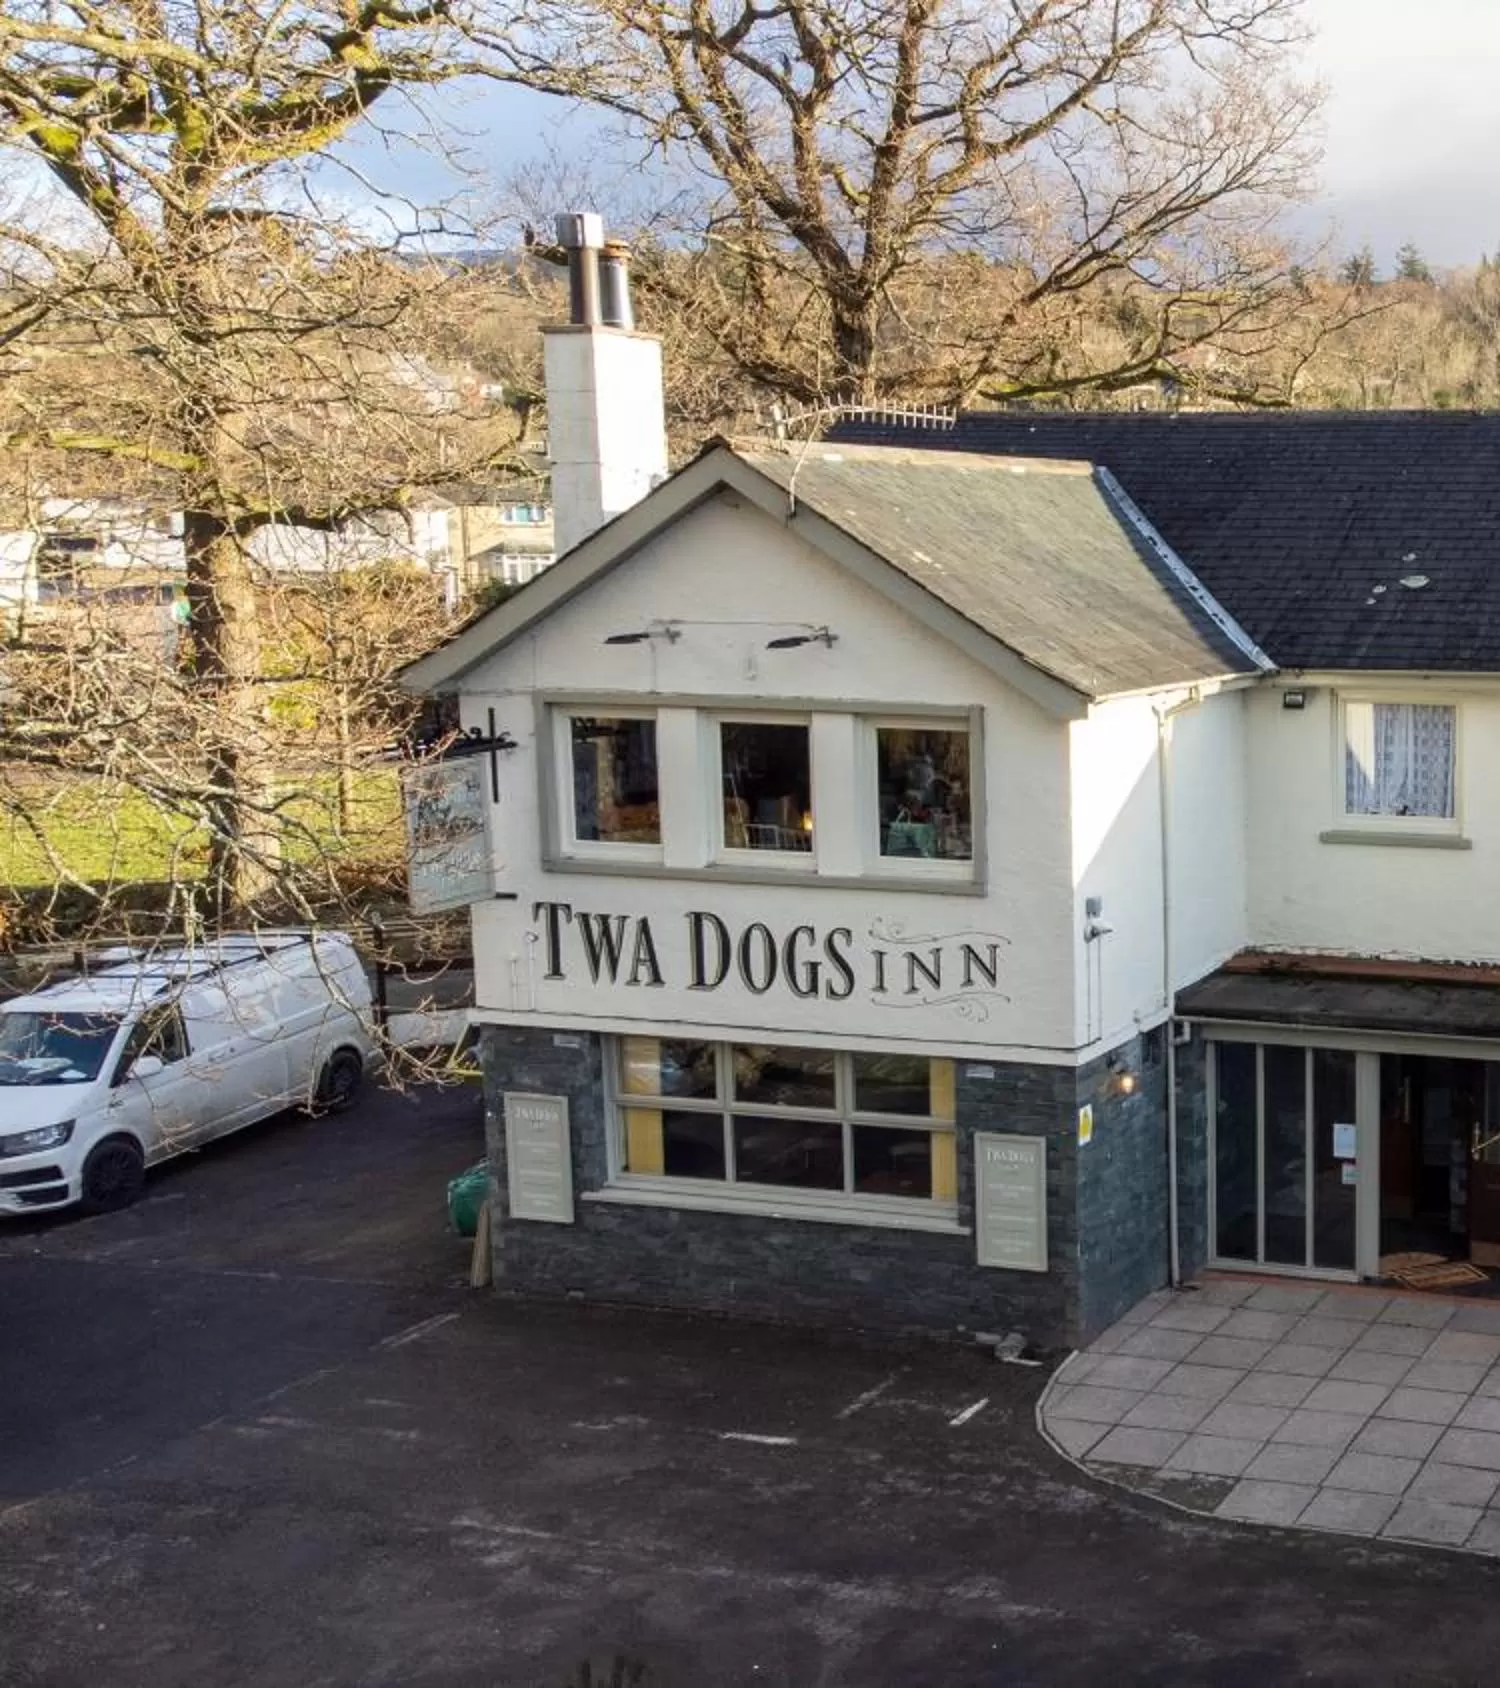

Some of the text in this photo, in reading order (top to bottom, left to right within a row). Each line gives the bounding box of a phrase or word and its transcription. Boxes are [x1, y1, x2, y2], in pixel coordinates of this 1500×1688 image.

[534, 900, 1001, 1000] TWA DOGS INN
